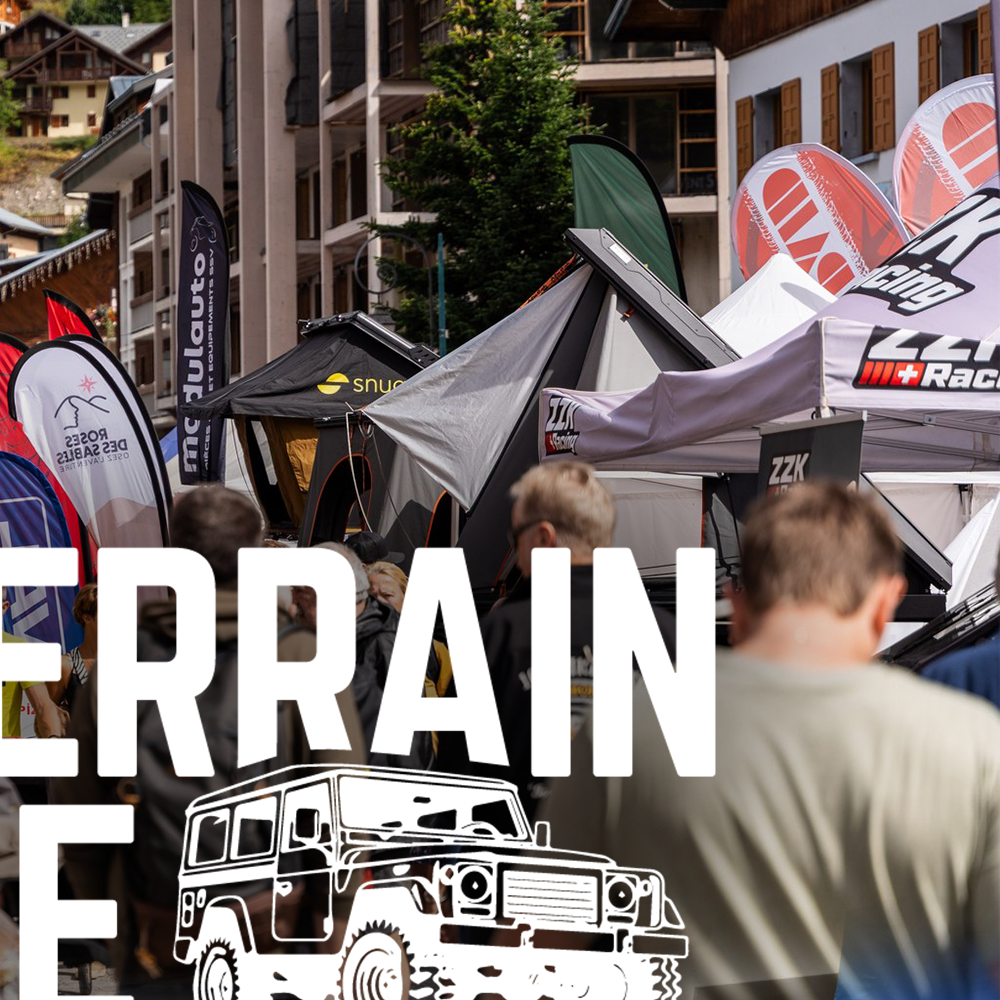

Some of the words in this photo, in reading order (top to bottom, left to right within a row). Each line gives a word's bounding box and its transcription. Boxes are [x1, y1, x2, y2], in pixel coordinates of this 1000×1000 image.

[860, 263, 964, 312] cing
[921, 363, 1000, 389] Rac
[546, 397, 580, 431] ZZK
[769, 453, 809, 485] ZZK
